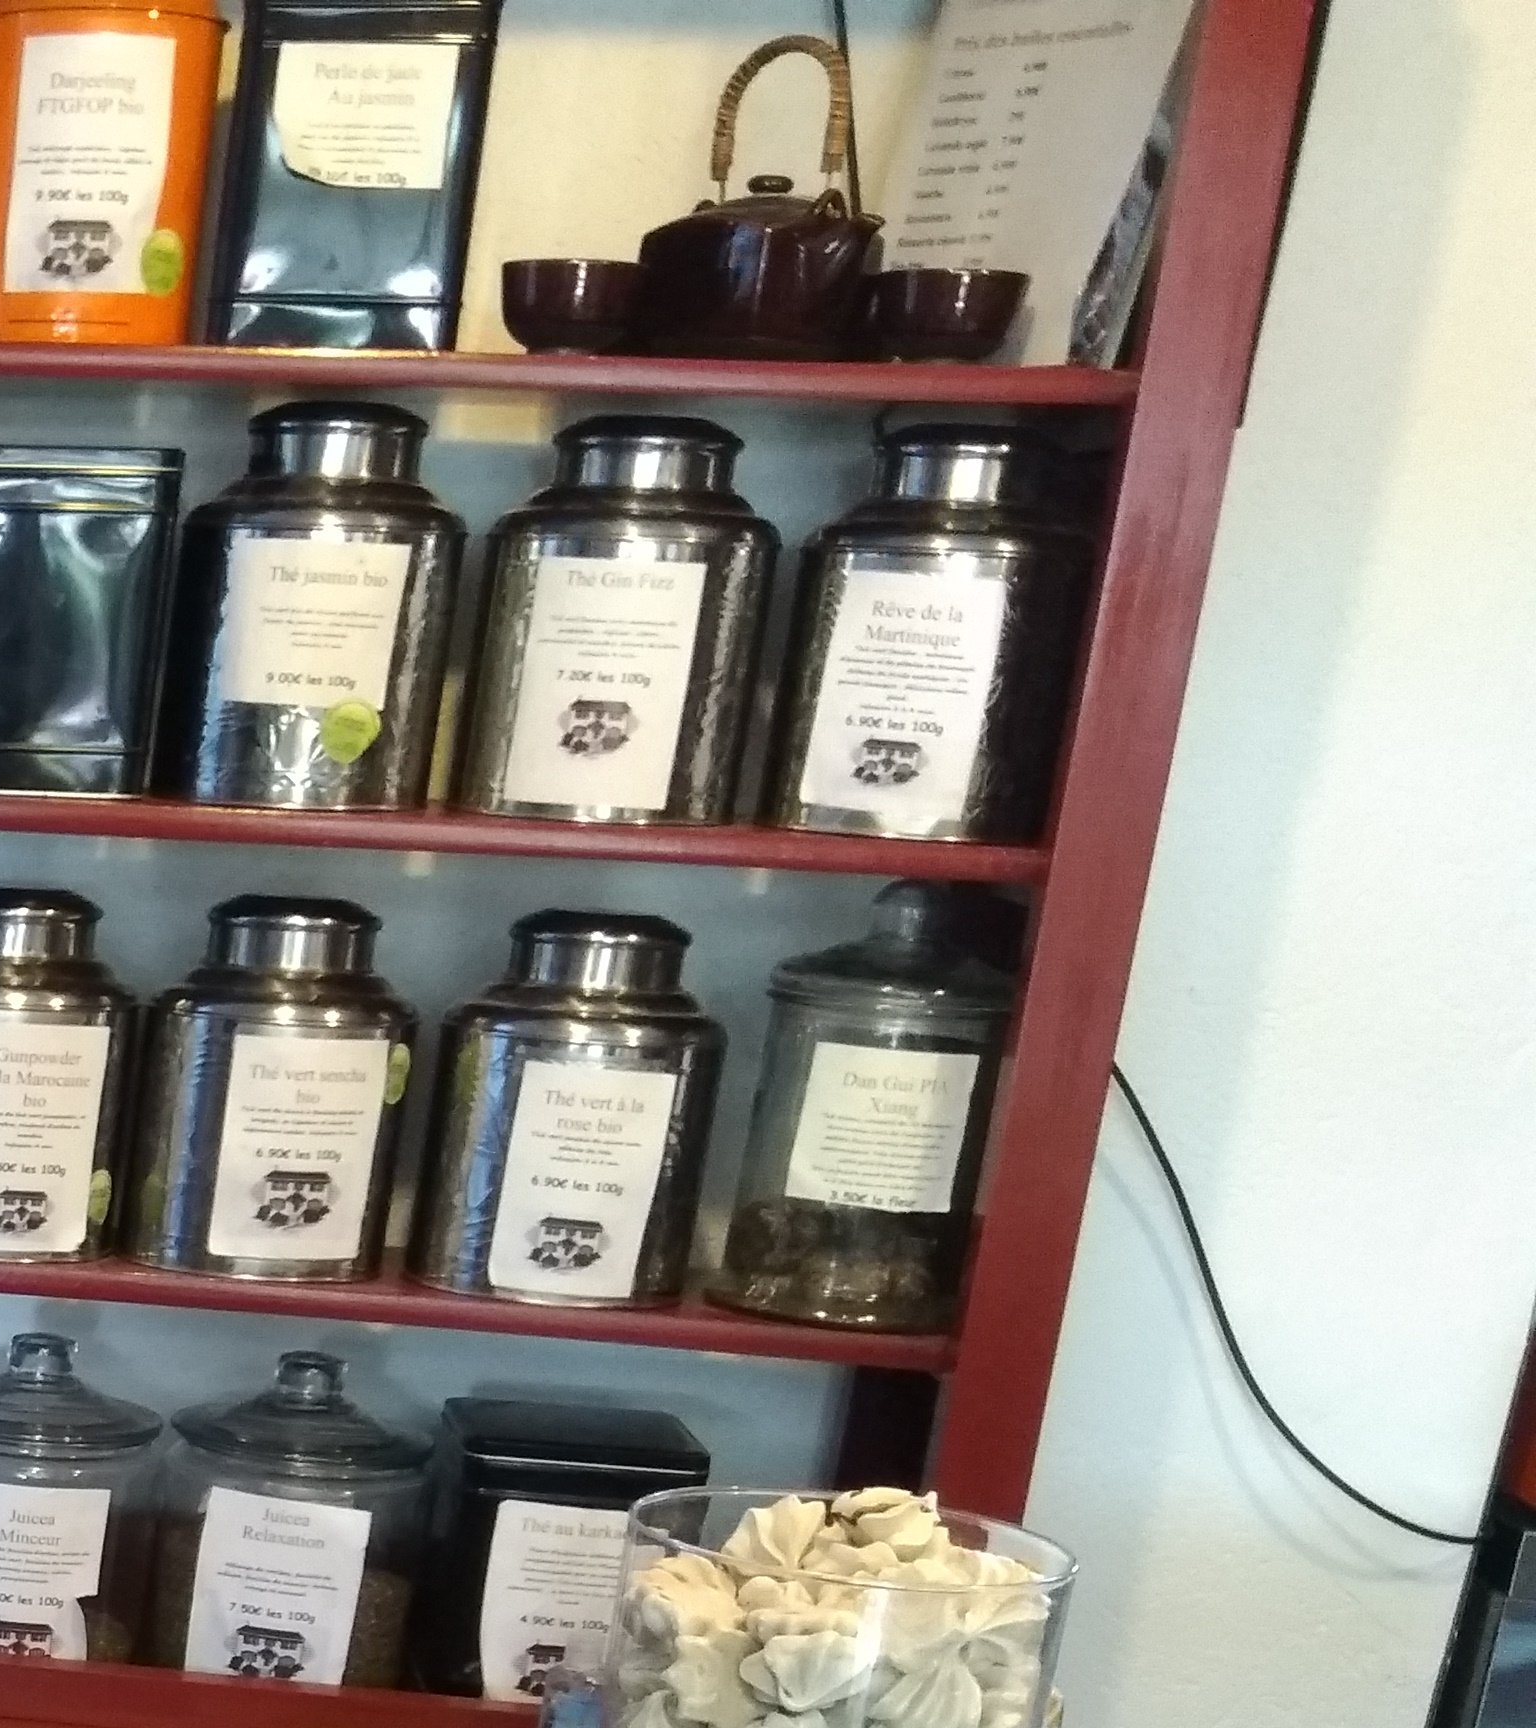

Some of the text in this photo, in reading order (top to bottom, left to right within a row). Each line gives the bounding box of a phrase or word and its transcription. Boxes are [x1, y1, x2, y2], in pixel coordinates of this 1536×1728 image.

[301, 567, 358, 587] jasmin
[920, 601, 943, 622] de
[948, 603, 963, 624] la
[864, 624, 961, 651] Martinique
[886, 717, 905, 731] les
[910, 718, 944, 737] 100g
[22, 1092, 47, 1110] bio
[544, 1088, 576, 1109] Thé
[580, 1092, 613, 1112] vert
[630, 1096, 645, 1114] la
[556, 1114, 624, 1134] rose bio
[294, 1149, 311, 1162] les
[20, 1163, 37, 1176] les
[40, 1164, 67, 1179] 100g
[572, 1178, 590, 1193] les
[595, 1180, 625, 1198] 100g
[8, 1508, 57, 1527] Juicea
[261, 1507, 310, 1528] Juicea
[521, 1517, 573, 1536] Thé au
[241, 1523, 326, 1551] Relaxation
[17, 1593, 33, 1607] les
[38, 1595, 65, 1611] 100g
[265, 1606, 283, 1621] les
[287, 1608, 316, 1626] 100g
[559, 1618, 576, 1630] les
[581, 1618, 610, 1635] 100g
